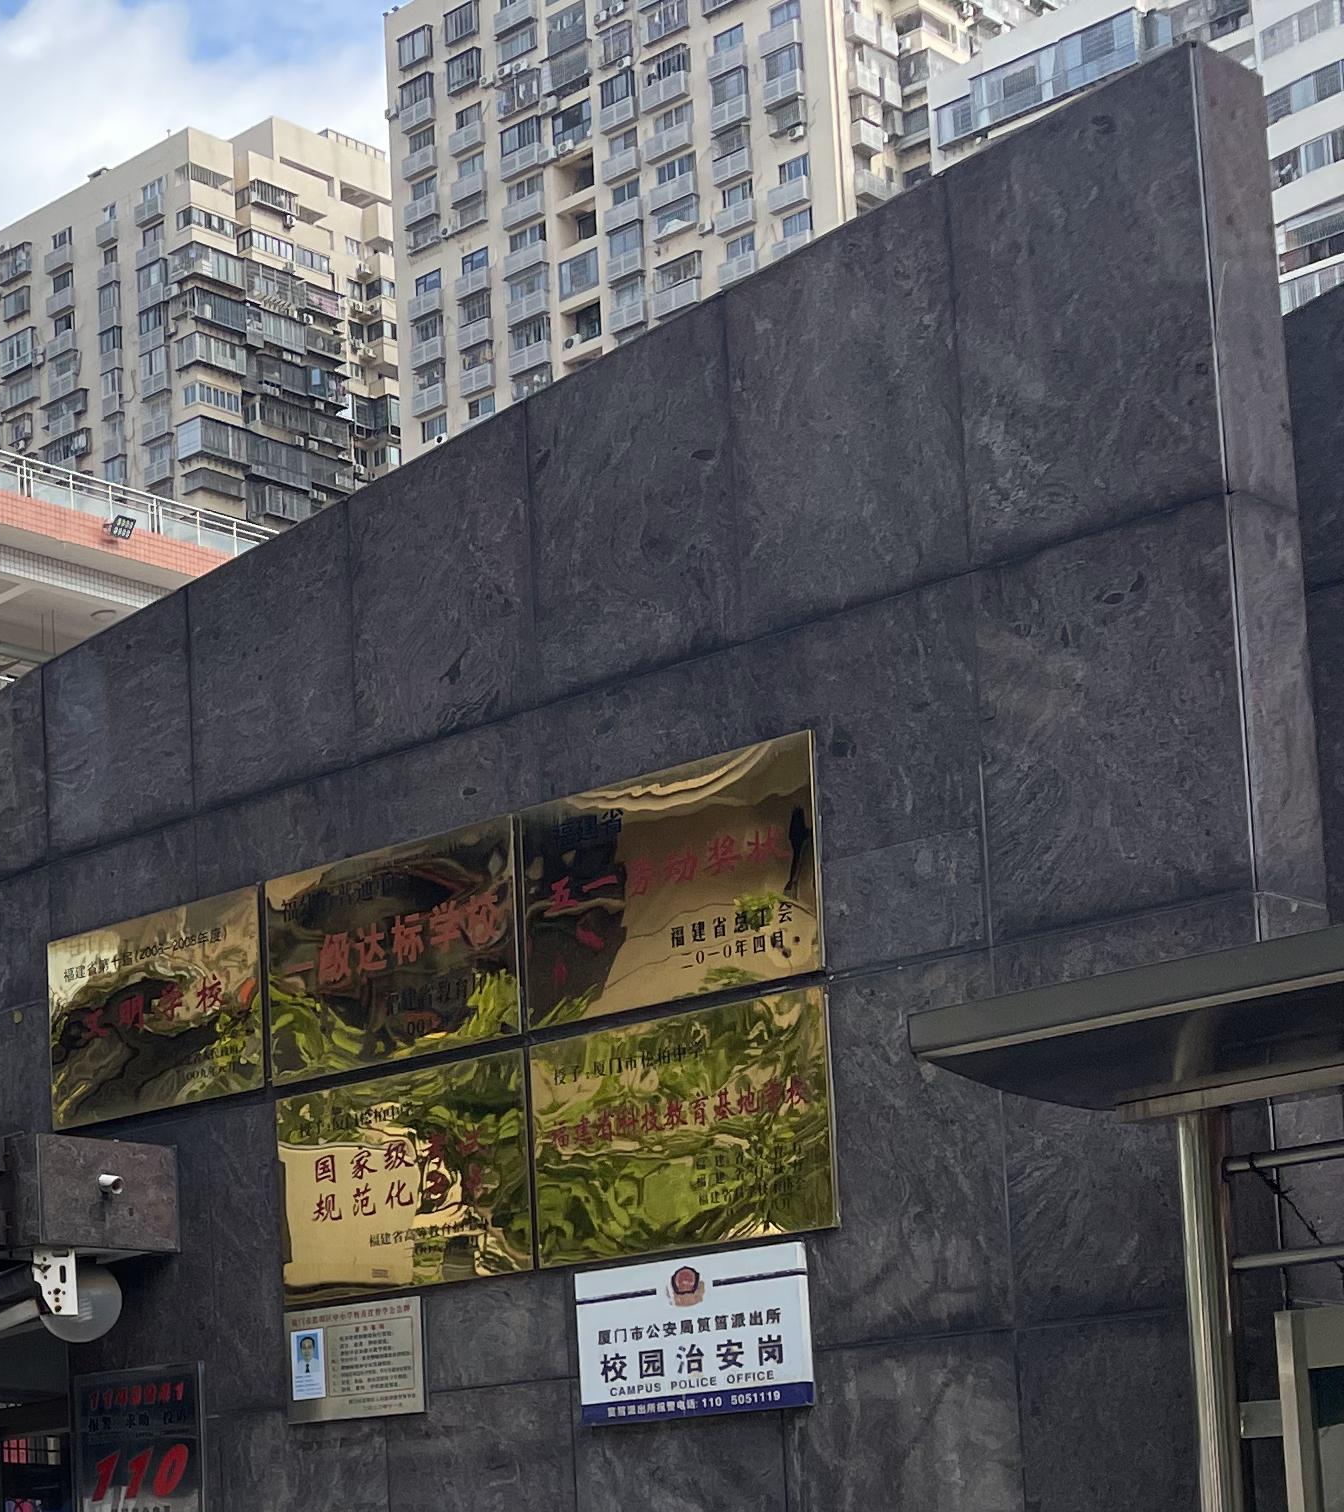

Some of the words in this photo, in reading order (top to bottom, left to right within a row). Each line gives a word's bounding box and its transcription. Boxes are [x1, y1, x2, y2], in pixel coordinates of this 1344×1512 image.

[544, 826, 792, 918] 五一劳动奖状
[82, 973, 224, 1041] 文明学校
[599, 1333, 785, 1384] 校园治安岗
[609, 1381, 662, 1398] CAMPUS
[670, 1375, 718, 1391] POLICE
[726, 1369, 775, 1385] OFFICE
[701, 1395, 723, 1409] 110
[730, 1390, 781, 1405] 5051119
[91, 1443, 189, 1503] 110
